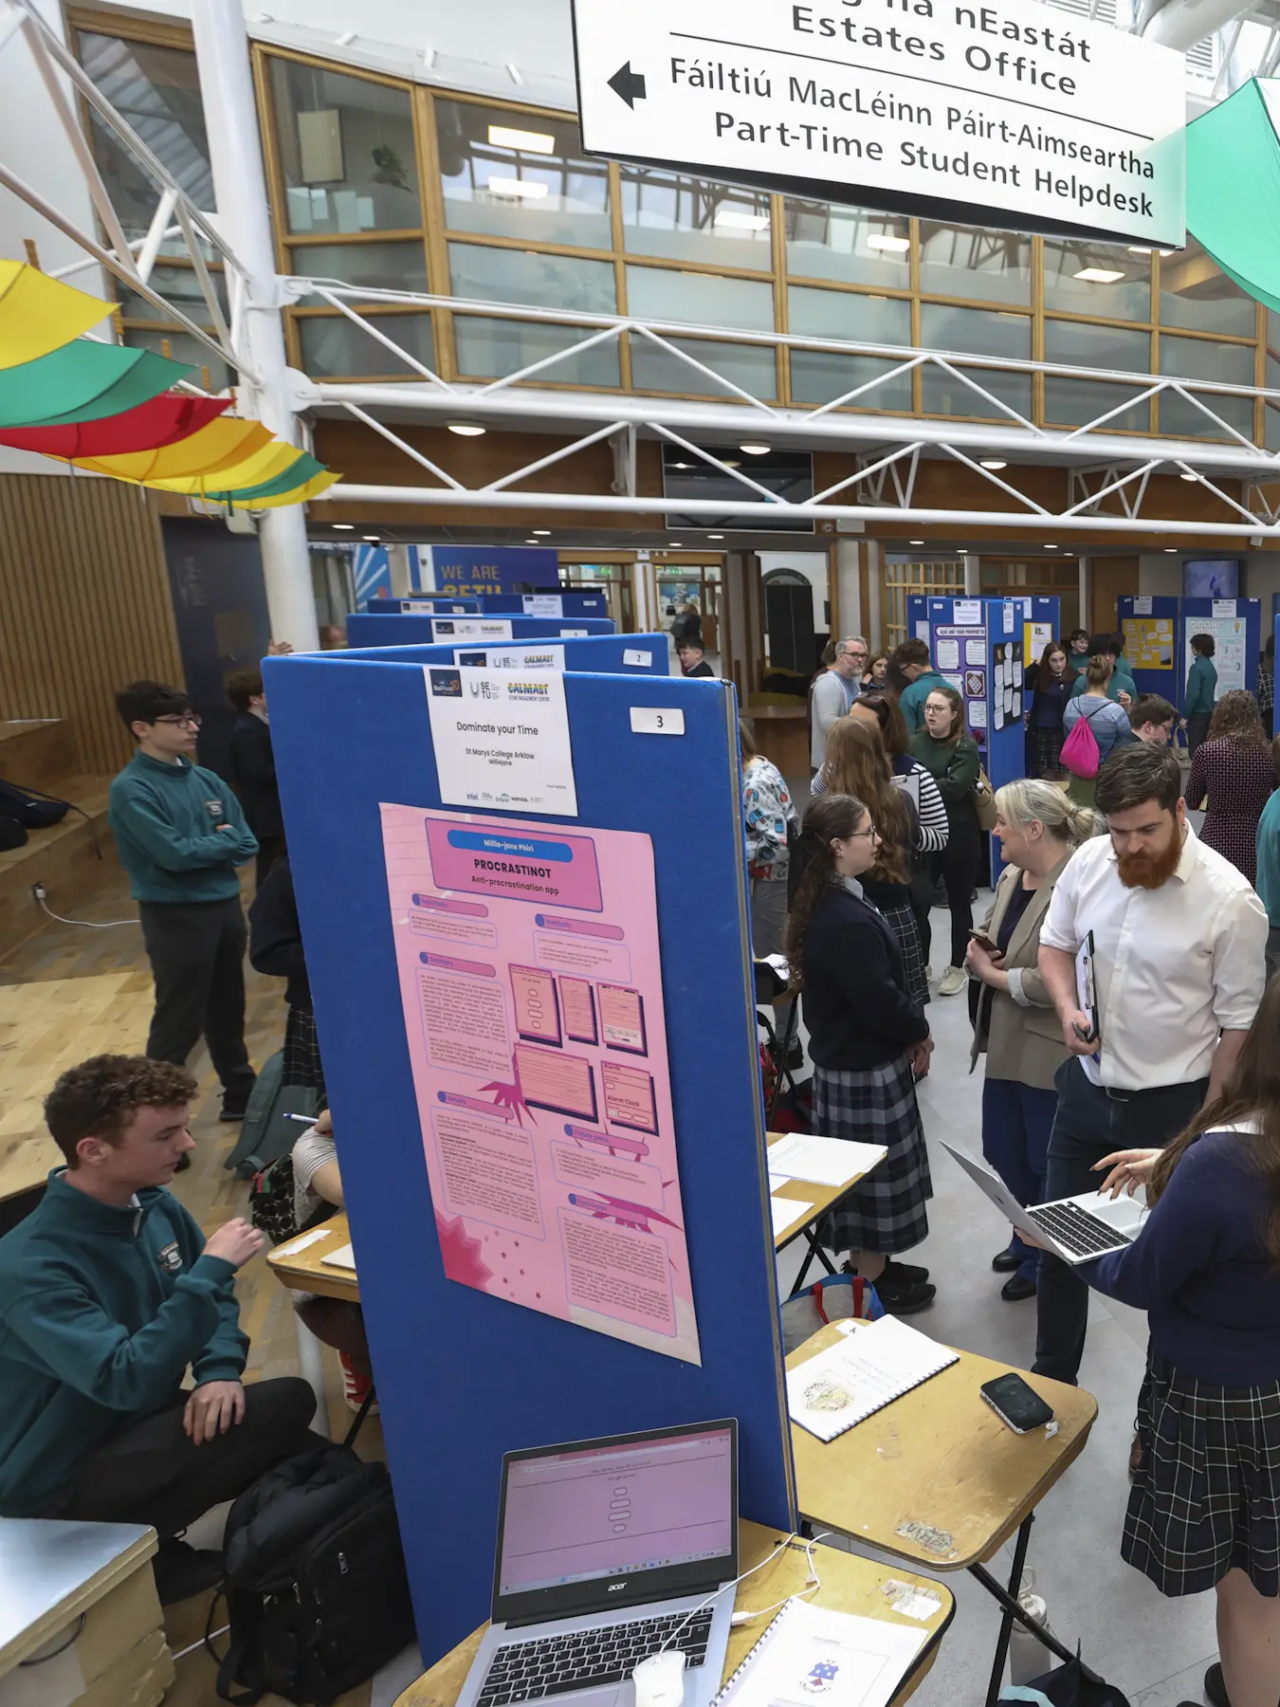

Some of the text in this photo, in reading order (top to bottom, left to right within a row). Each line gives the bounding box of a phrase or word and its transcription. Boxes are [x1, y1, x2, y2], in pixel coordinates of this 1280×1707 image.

[955, 6, 1091, 63] nEastát
[792, 5, 1076, 96] Estates Office
[669, 57, 1155, 179] Fáiltiú MacLéinn Páirt-Aimseartha
[715, 112, 1154, 218] Part-Time Student Helpdesk
[440, 565, 499, 580] WE ARE
[636, 654, 642, 663] 2
[457, 722, 539, 736] Dominate your Time
[656, 715, 665, 728] 3
[472, 748, 490, 758] Marys
[491, 750, 513, 760] College
[514, 751, 535, 760] Arklow
[473, 858, 552, 879] PROCRASTINOT
[471, 875, 560, 896] Anti-procrastination app
[607, 1582, 628, 1592] acer
